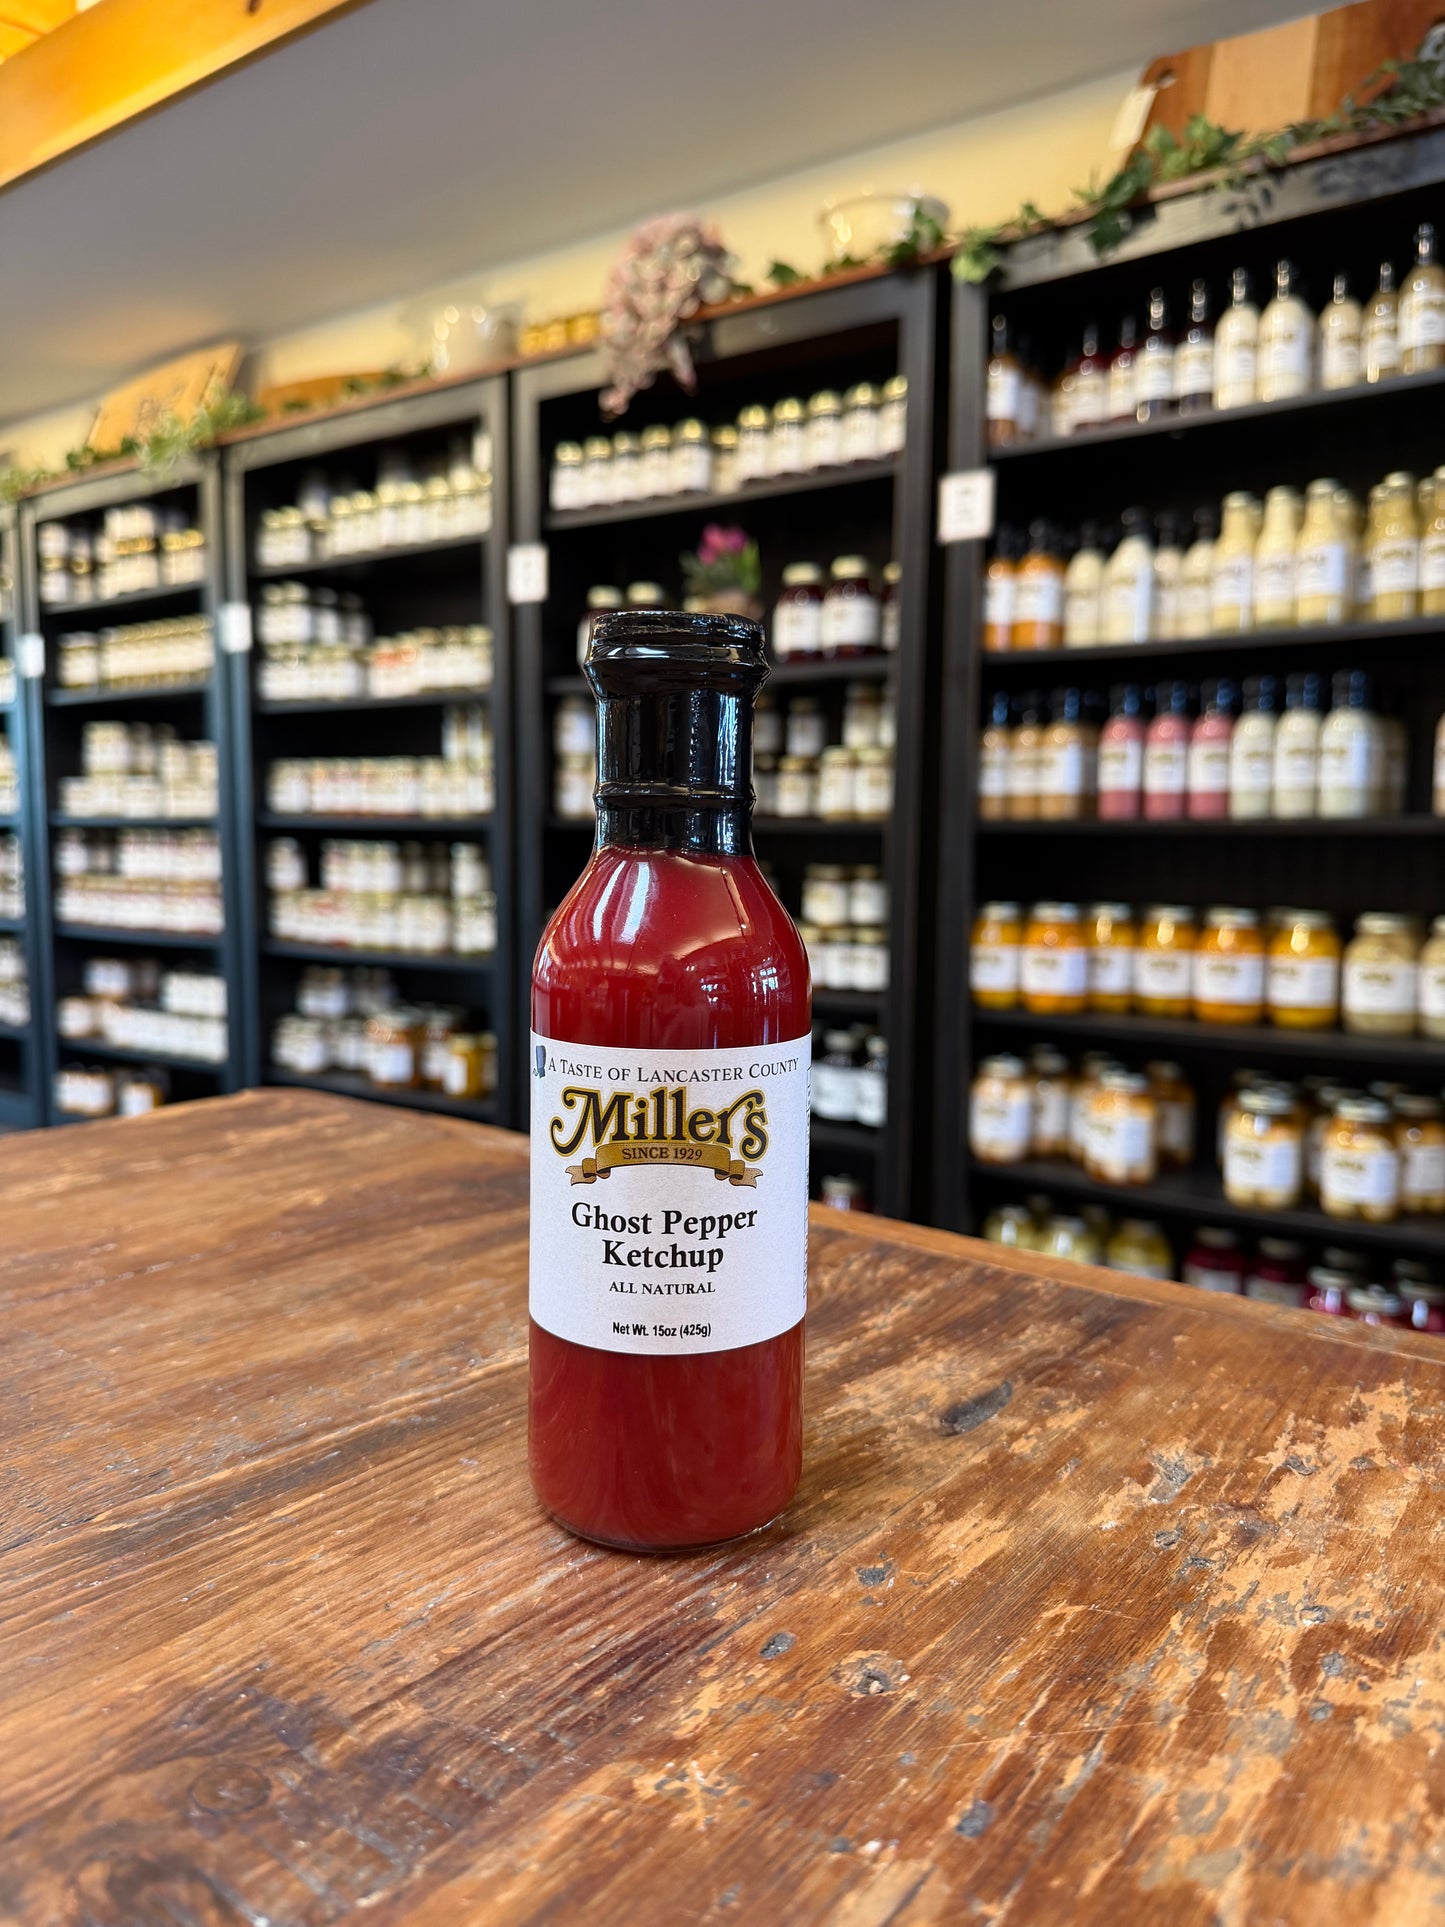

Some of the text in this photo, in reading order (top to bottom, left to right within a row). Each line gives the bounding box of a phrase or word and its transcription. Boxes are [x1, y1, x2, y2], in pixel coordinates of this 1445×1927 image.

[548, 1057, 799, 1083] A TASTE OF LANCASTER COUNTY
[550, 1086, 768, 1163] Miller's
[622, 1148, 703, 1161] SINCE 1929
[571, 1202, 758, 1240] Ghost Pepper
[602, 1240, 724, 1272] Ketchup
[609, 1281, 716, 1295] ALL NATURAL
[613, 1322, 711, 1339] Net Wt. 15oz (425g)
